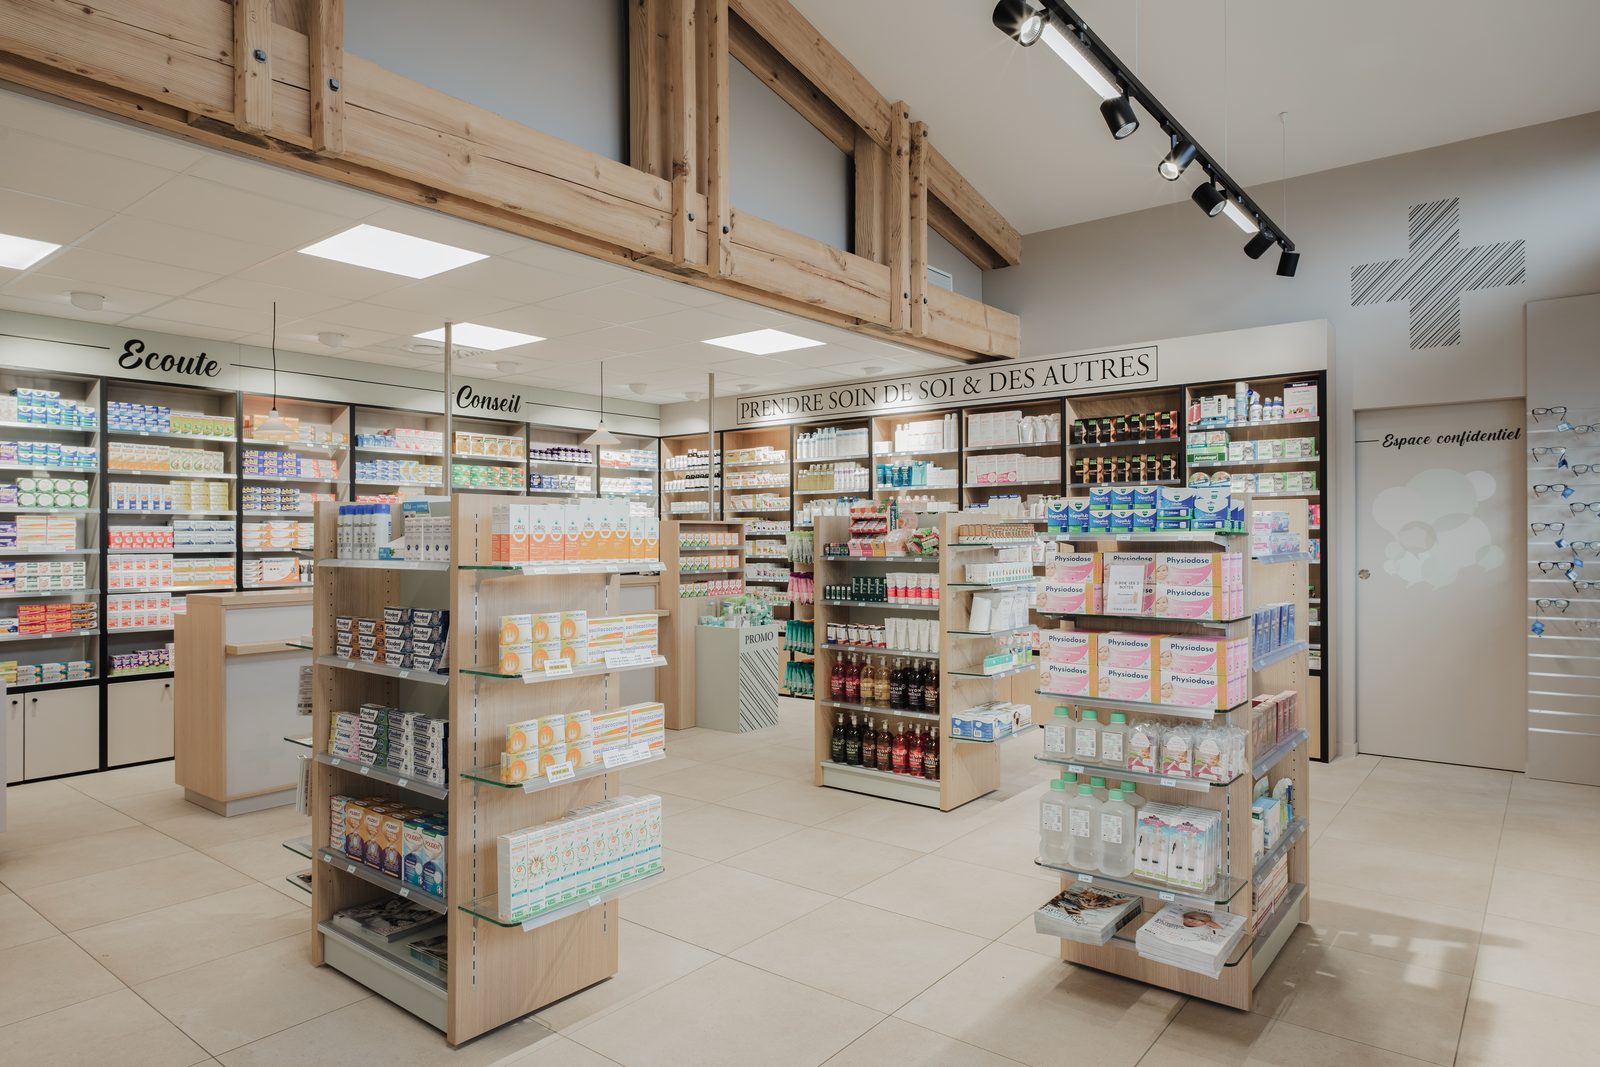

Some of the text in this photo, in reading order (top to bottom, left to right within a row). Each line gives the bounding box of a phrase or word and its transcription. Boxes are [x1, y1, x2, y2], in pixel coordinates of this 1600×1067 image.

[118, 339, 222, 377] Ecoute
[740, 353, 1150, 419] PRENDRE SOIN DE SOI & DES AUTRES
[456, 385, 522, 413] Conseil
[1382, 427, 1522, 450] Espace confidentiel
[1054, 555, 1091, 563] Physiodose
[1166, 556, 1210, 565] Physiodose
[1045, 586, 1083, 594] Physiodose
[1167, 589, 1210, 598] Physiodose
[745, 632, 774, 644] PROMO
[1048, 635, 1086, 644] Physiodose
[1108, 638, 1148, 648] Physiodose
[1170, 643, 1214, 653] Physiodose
[1049, 665, 1087, 674] Physiodose
[1108, 670, 1149, 680] Physiodose
[1171, 675, 1215, 686] Physiodose
